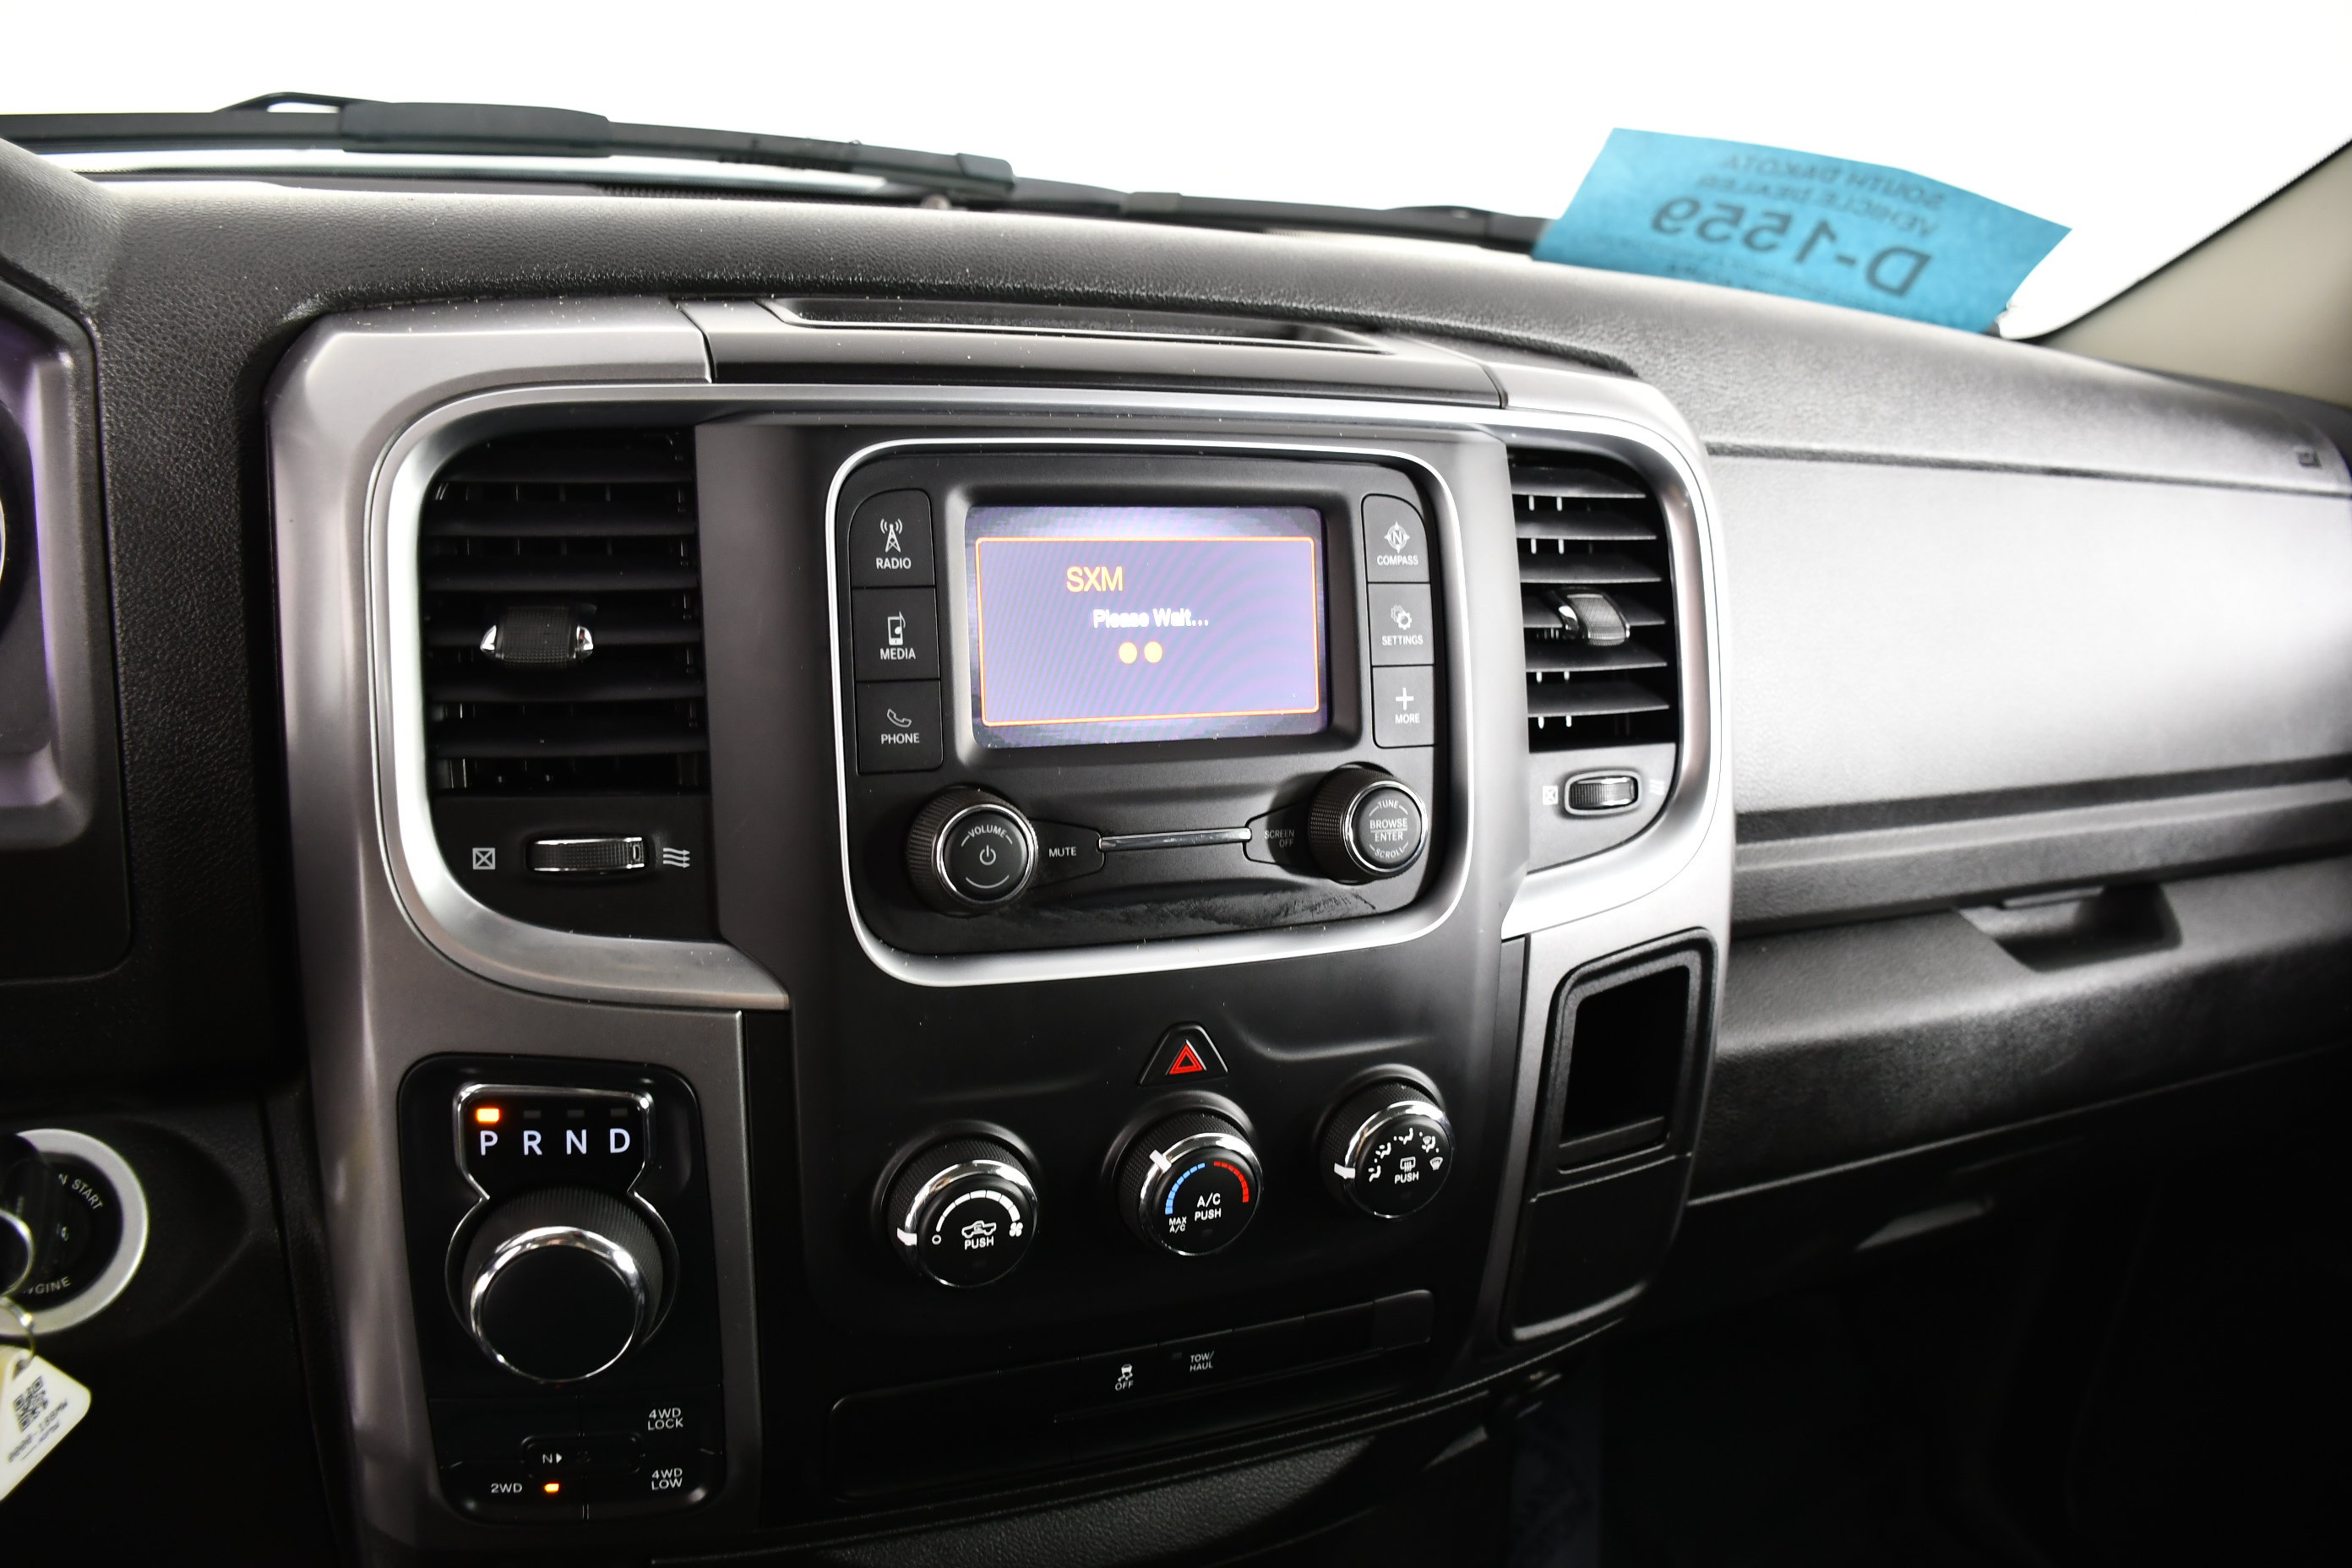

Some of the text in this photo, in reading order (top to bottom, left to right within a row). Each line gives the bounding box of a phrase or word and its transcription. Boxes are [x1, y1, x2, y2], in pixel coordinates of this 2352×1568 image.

[875, 557, 912, 570] RADIO
[1376, 554, 1418, 566] COMPASS
[1065, 566, 1124, 592] SXM
[1093, 608, 1209, 628] Please Wait...
[1381, 634, 1424, 646] SETTINGS
[879, 647, 916, 662] MEDIA
[1394, 713, 1420, 724] MORE
[880, 731, 920, 745] PHONE
[1378, 799, 1399, 809] TUNE
[1369, 818, 1407, 828] BROWSE
[968, 825, 1007, 838] VOLUME
[1264, 830, 1295, 839] SCREEN
[1375, 831, 1403, 842] ENTER
[1279, 839, 1293, 847] OFF
[1048, 847, 1077, 858] MUTE
[1375, 847, 1404, 859] SCROLL
[480, 1128, 631, 1156] P R N D
[1394, 1171, 1419, 1184] PUSH
[72, 1179, 103, 1209] START
[1196, 1192, 1221, 1207] A/C
[1194, 1207, 1222, 1221] PUSH
[1168, 1217, 1187, 1226] MAX
[1170, 1224, 1186, 1233] A/C
[964, 1236, 995, 1250] PUSH
[1190, 1351, 1215, 1364] TOW/
[1190, 1360, 1213, 1372] HAUL
[1114, 1380, 1134, 1391] OFF
[649, 1407, 682, 1419] 4WD
[647, 1418, 683, 1431] LOCK
[542, 1454, 553, 1464] N
[651, 1467, 683, 1479] 4WD
[491, 1484, 523, 1494] 2WD
[651, 1478, 683, 1490] LOW
